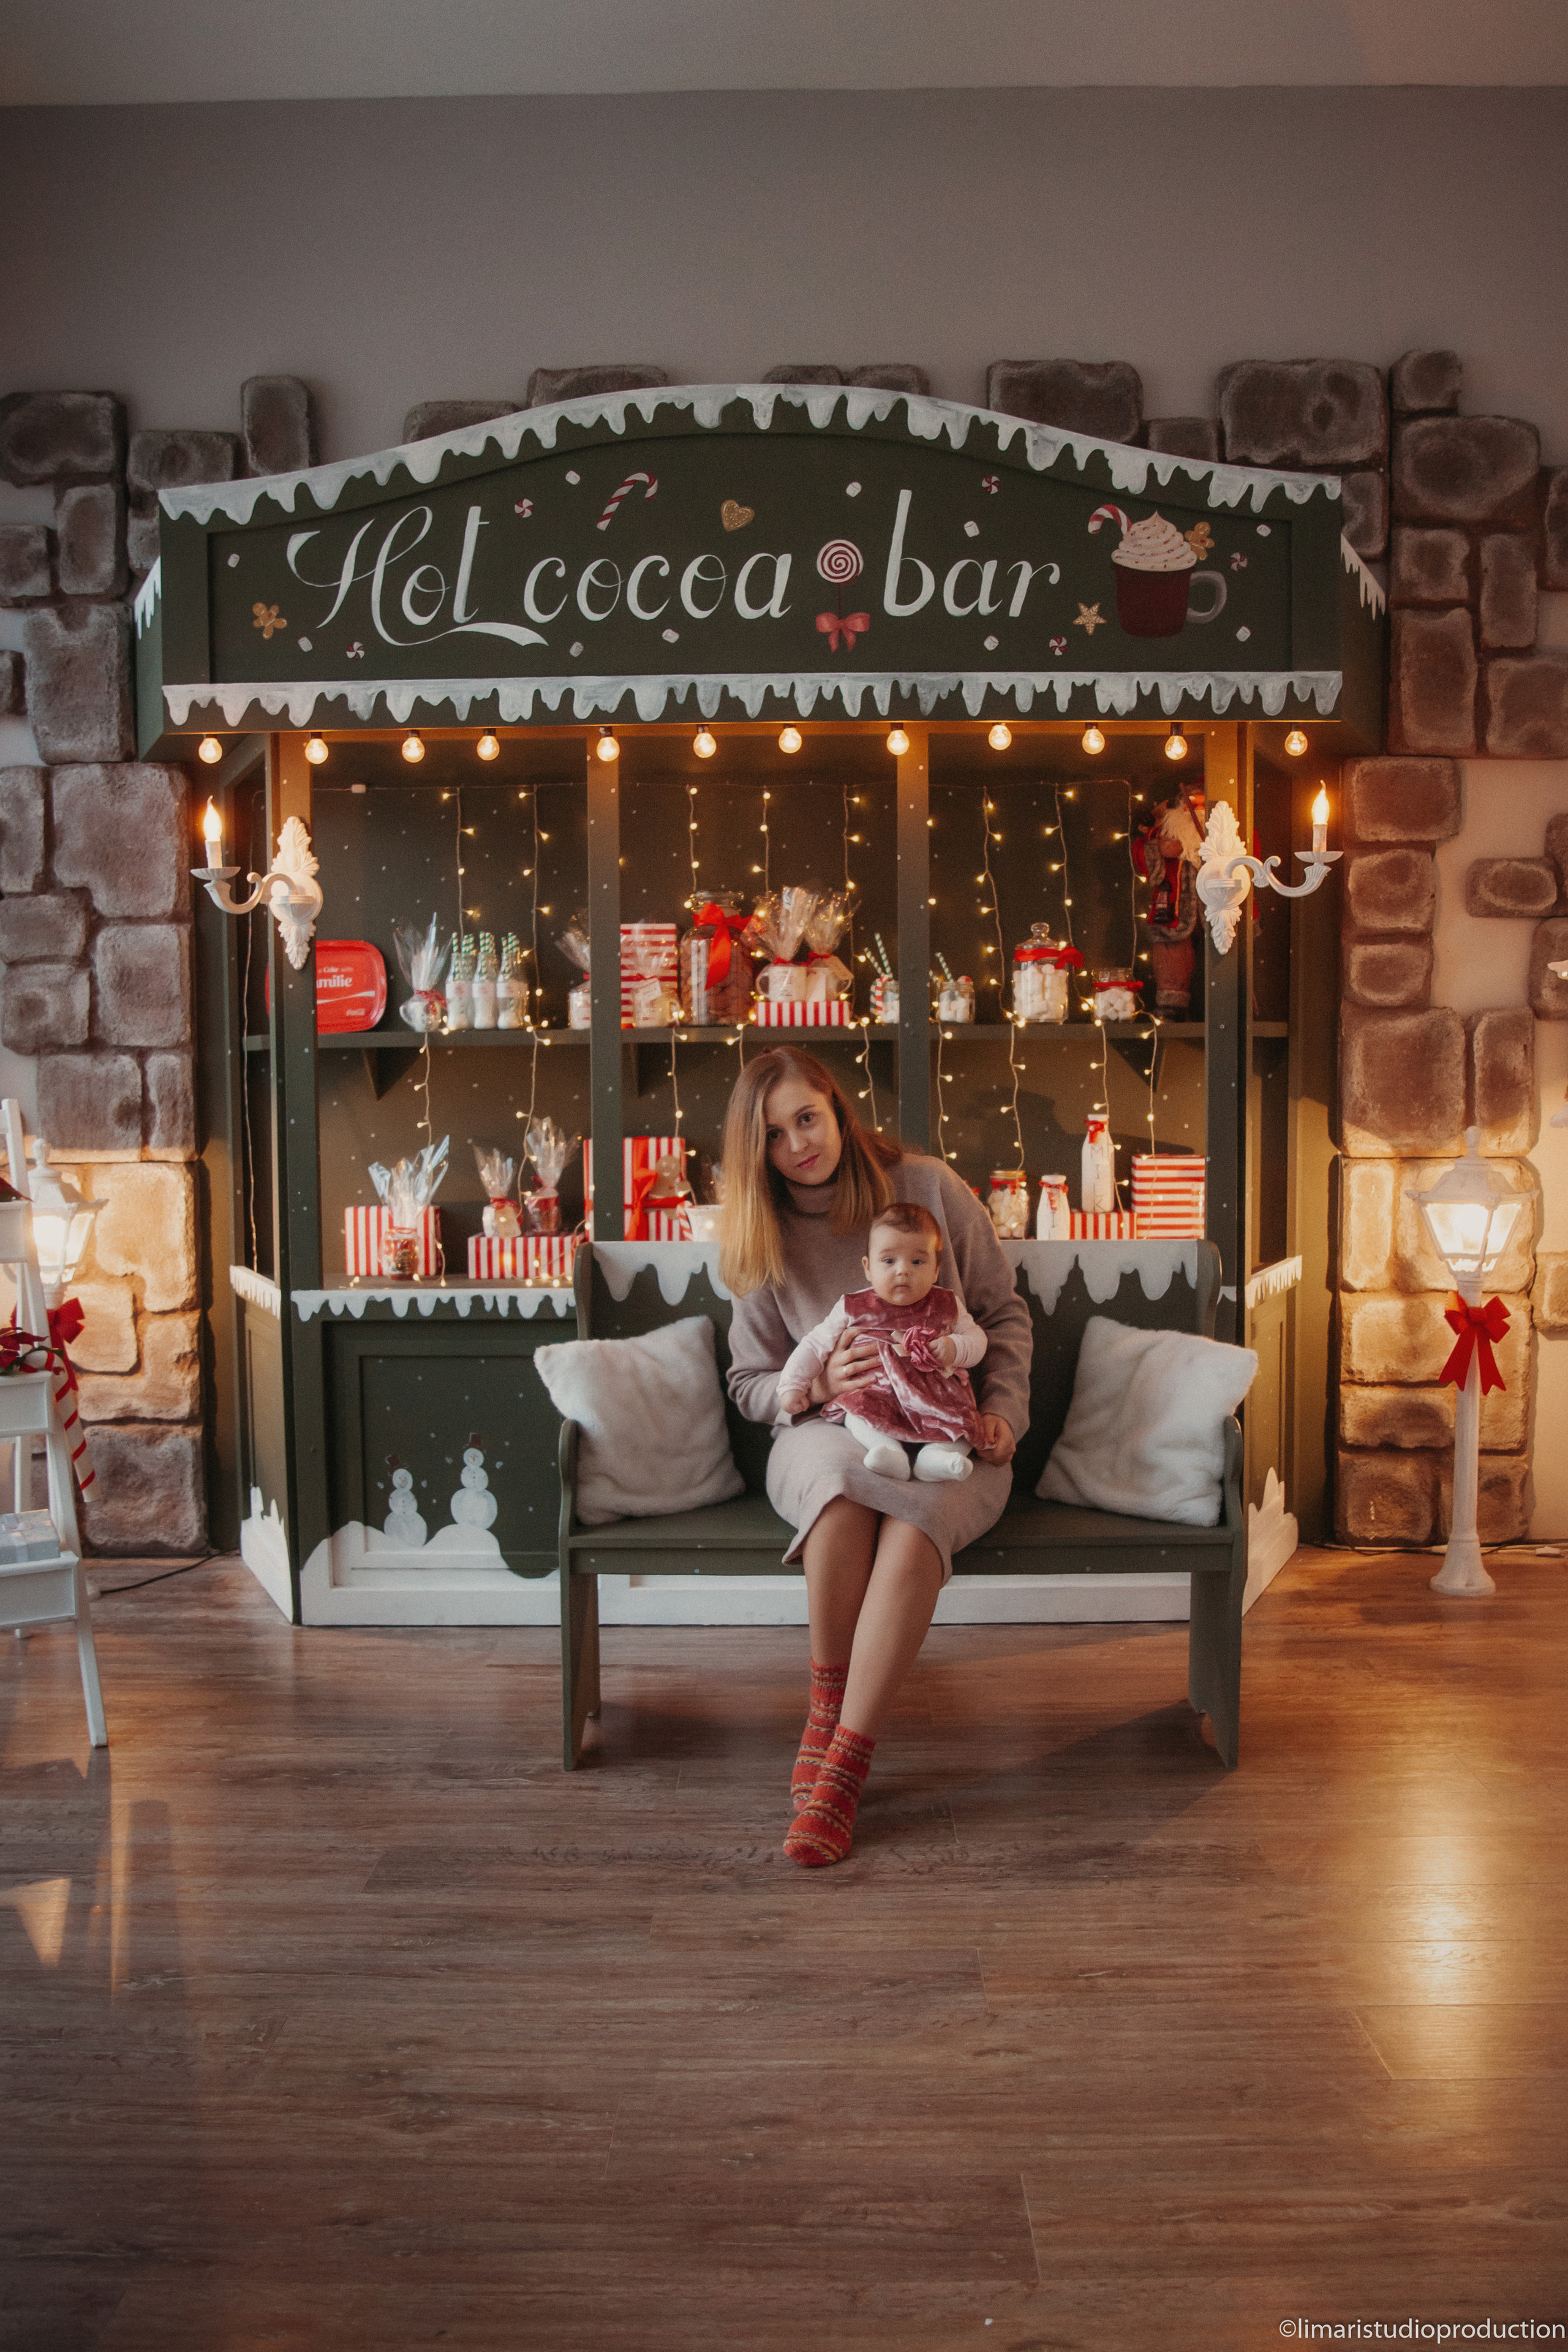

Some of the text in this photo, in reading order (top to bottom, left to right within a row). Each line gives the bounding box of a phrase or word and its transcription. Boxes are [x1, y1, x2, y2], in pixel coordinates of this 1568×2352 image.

[286, 489, 1060, 646] Hot cocoa bar
[316, 974, 352, 988] milie
[1090, 1145, 1106, 1213] MILK
